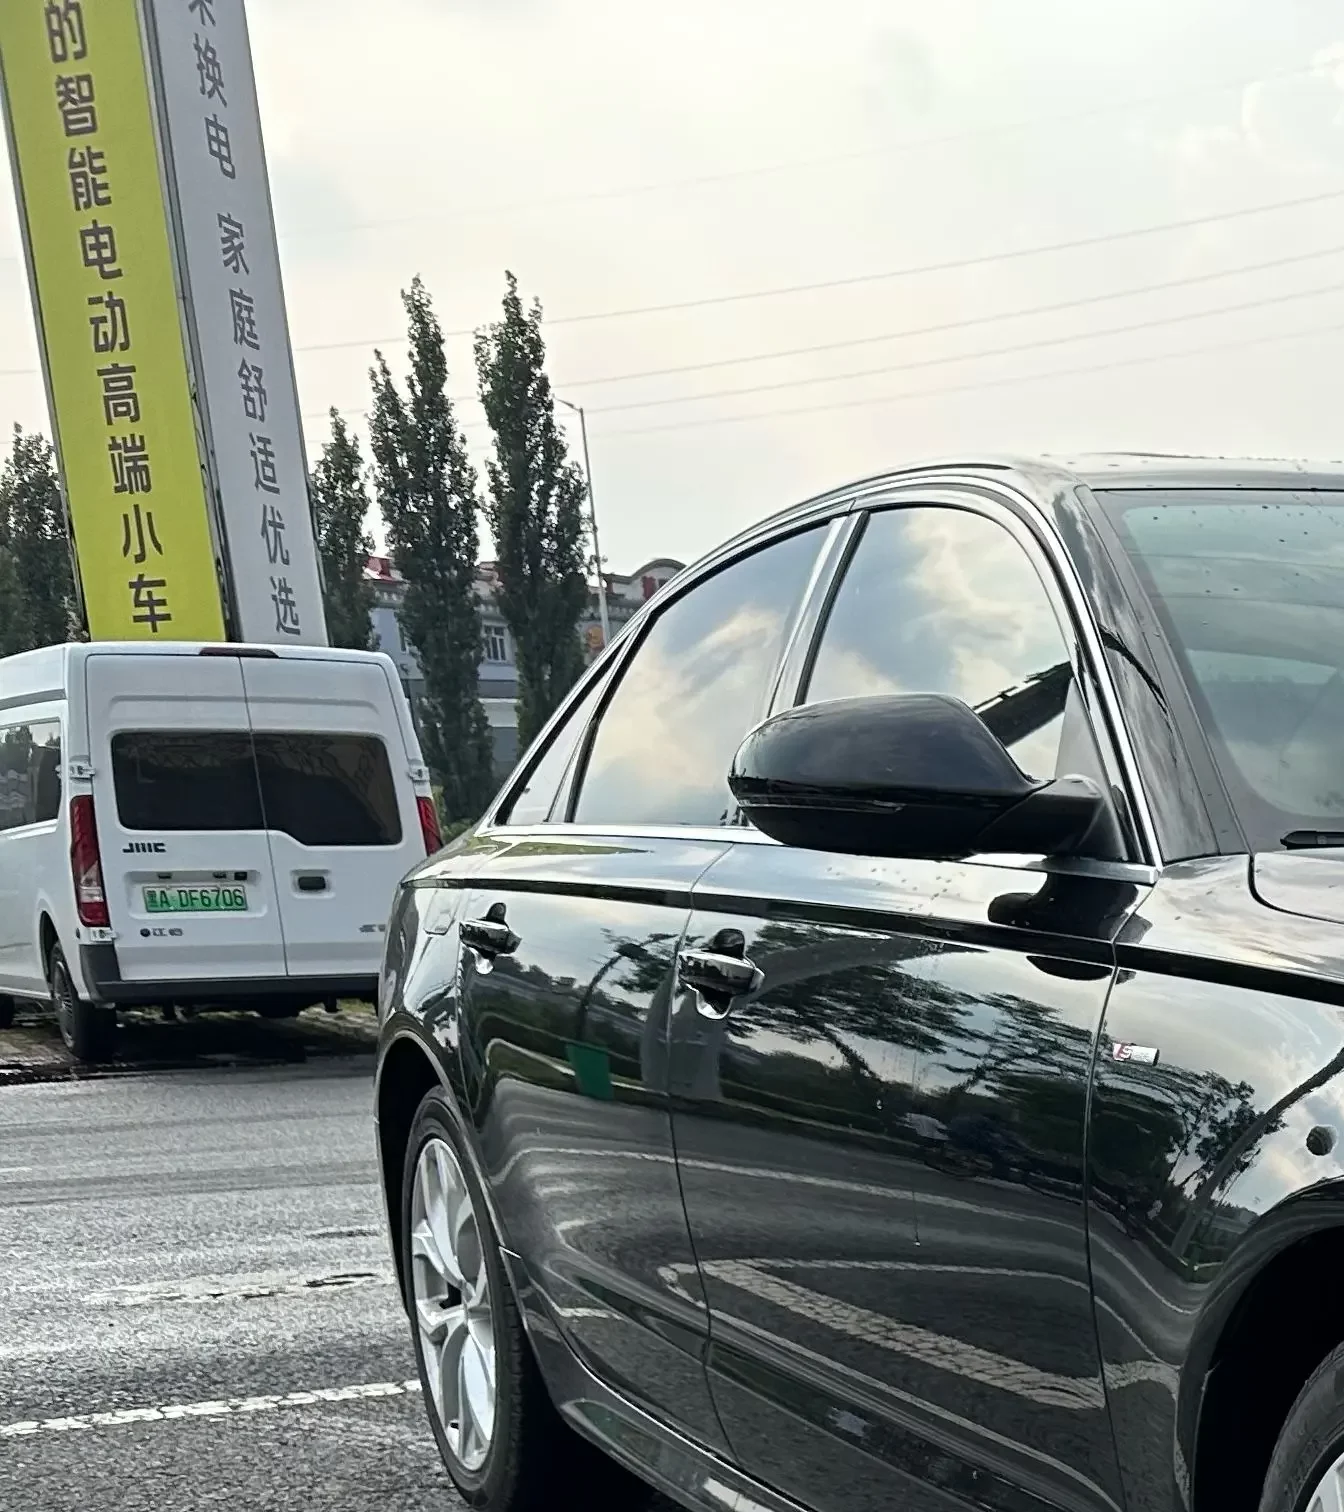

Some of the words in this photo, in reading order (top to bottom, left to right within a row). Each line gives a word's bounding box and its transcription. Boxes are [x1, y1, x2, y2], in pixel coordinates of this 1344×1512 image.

[42, 0, 173, 635] 的智能电动高端小车
[215, 212, 301, 636] 家庭舒适优选
[177, 888, 245, 908] DF6706
